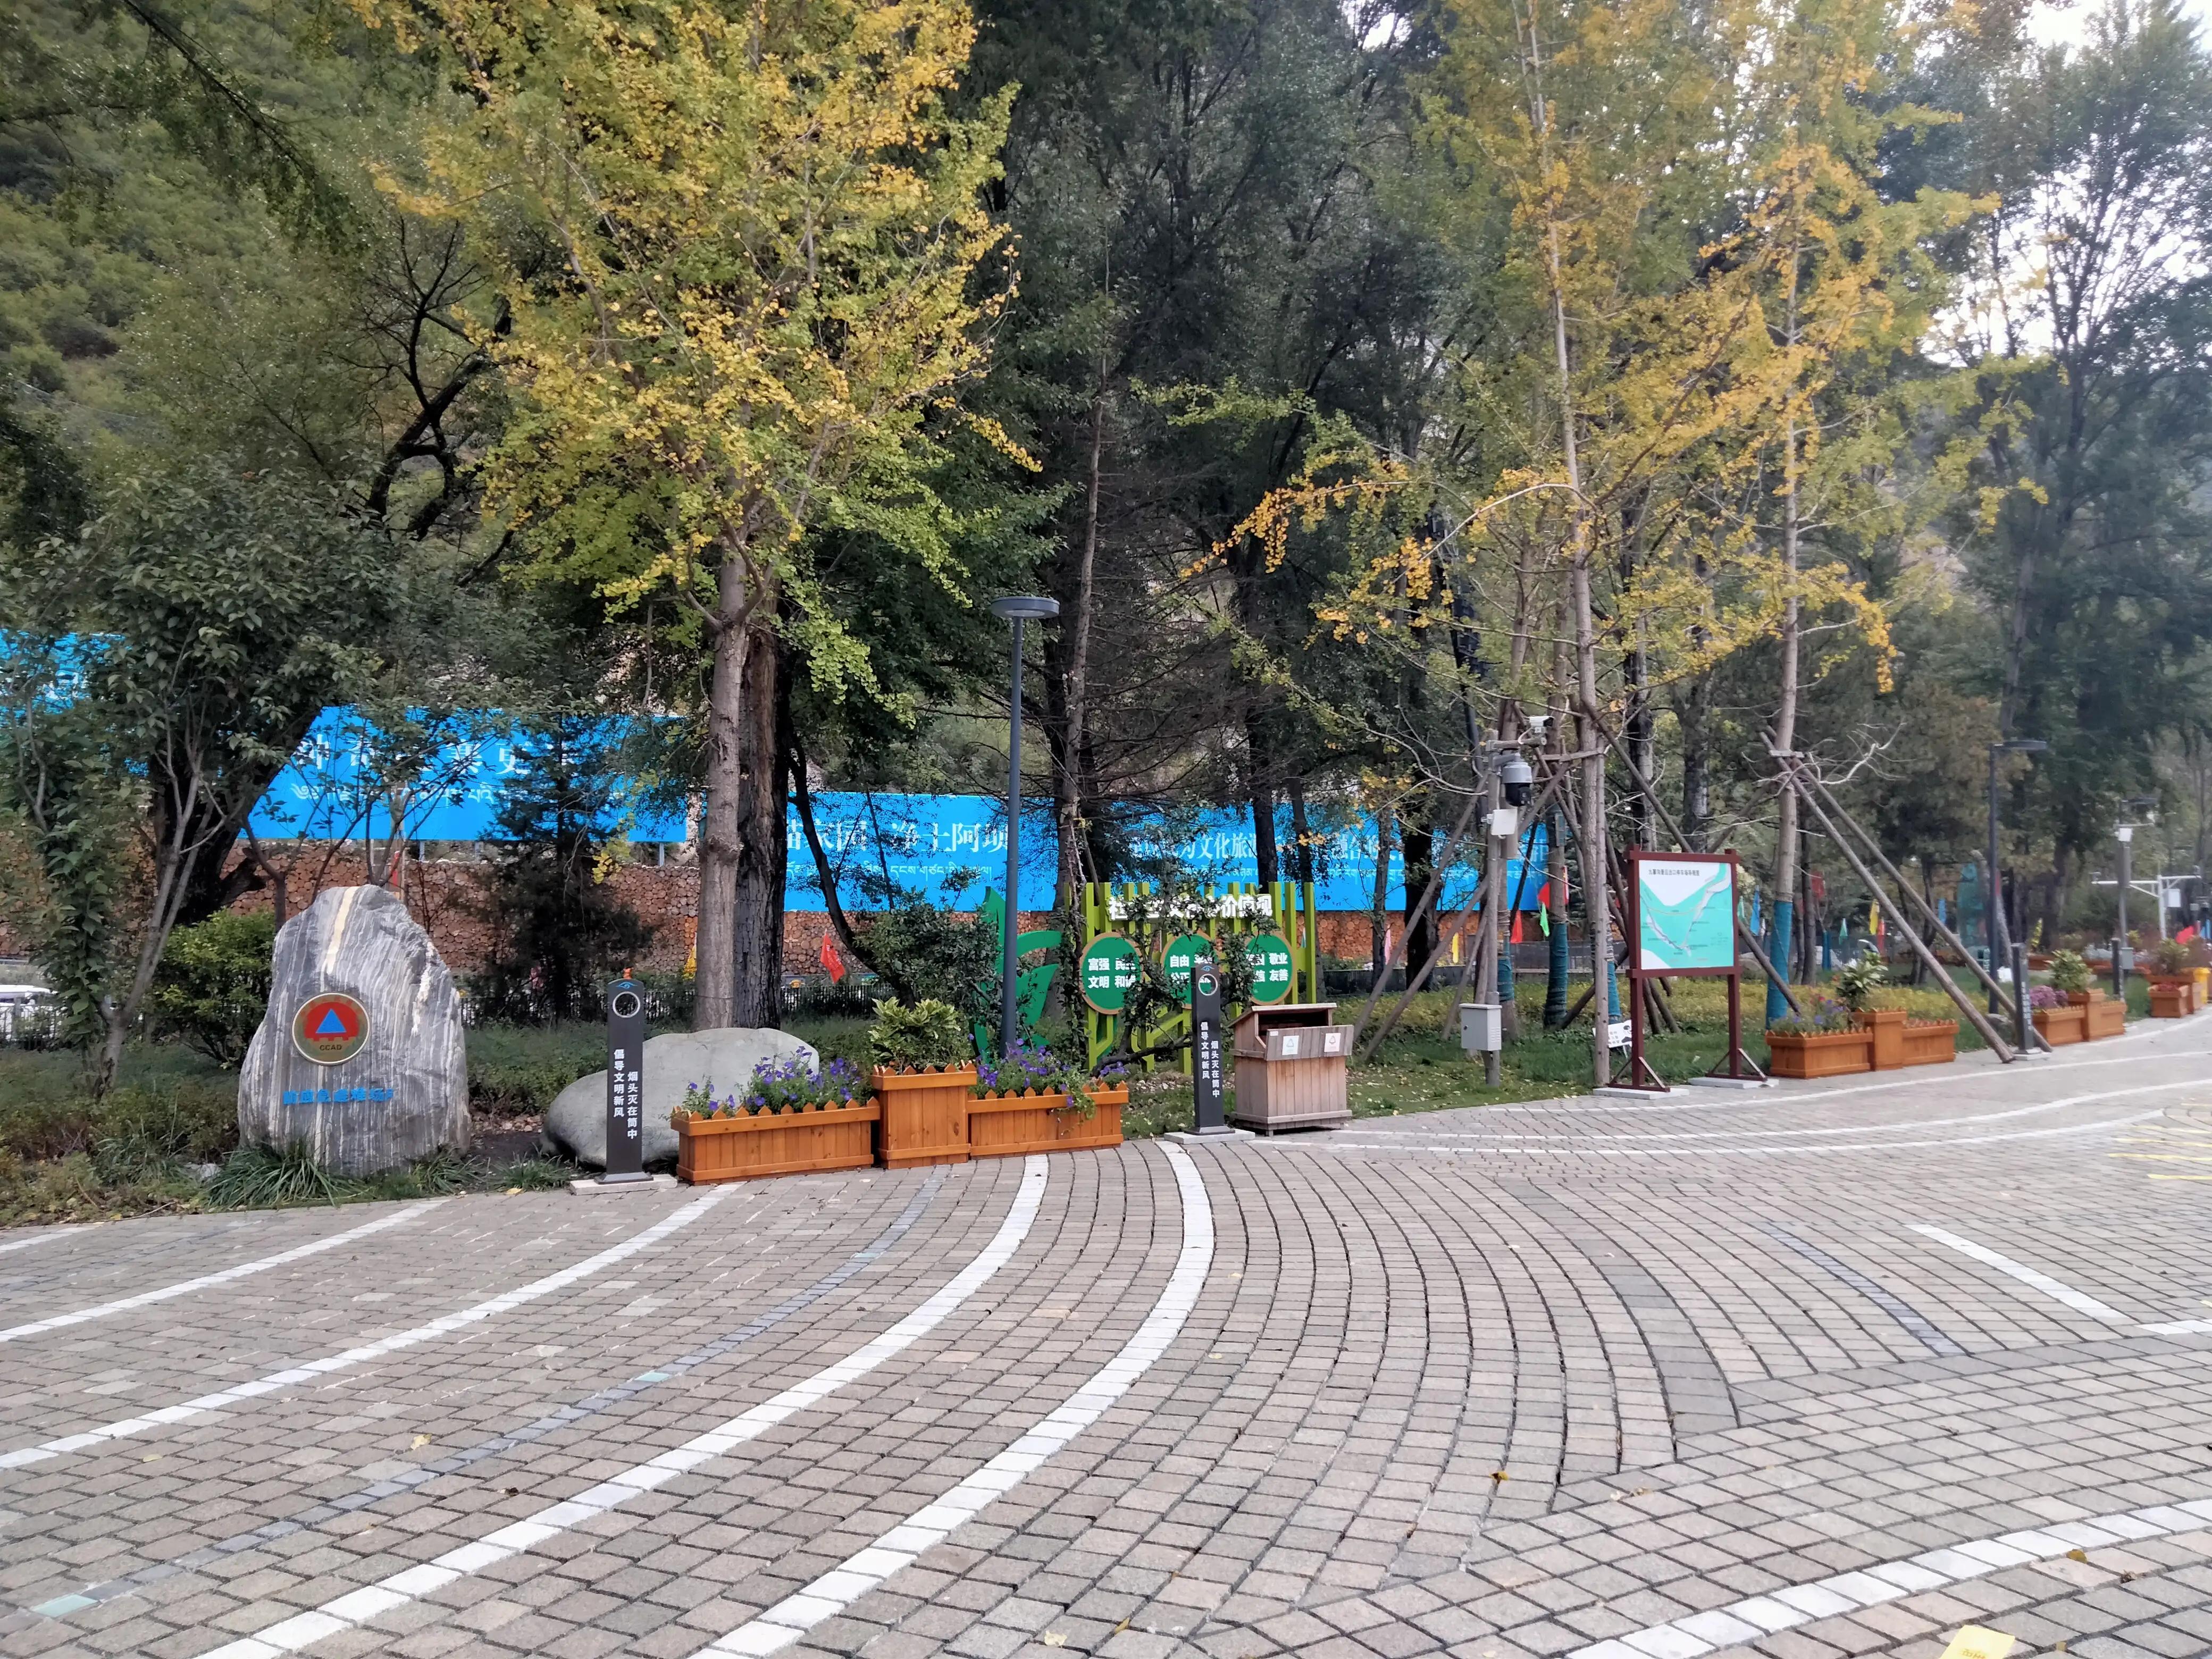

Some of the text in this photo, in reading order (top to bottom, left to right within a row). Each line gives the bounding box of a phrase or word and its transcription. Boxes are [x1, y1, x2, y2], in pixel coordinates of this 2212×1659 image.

[1088, 958, 1136, 971] 富强 民主
[1170, 954, 1189, 968] 自由
[1269, 952, 1288, 965] 敬业
[1088, 976, 1109, 988] 文明
[1269, 968, 1288, 982] 友善
[1201, 1021, 1210, 1079] 倡导文明新风
[614, 1049, 625, 1117] 倡导文明新风
[627, 1071, 638, 1139] 烟头灭在筒中
